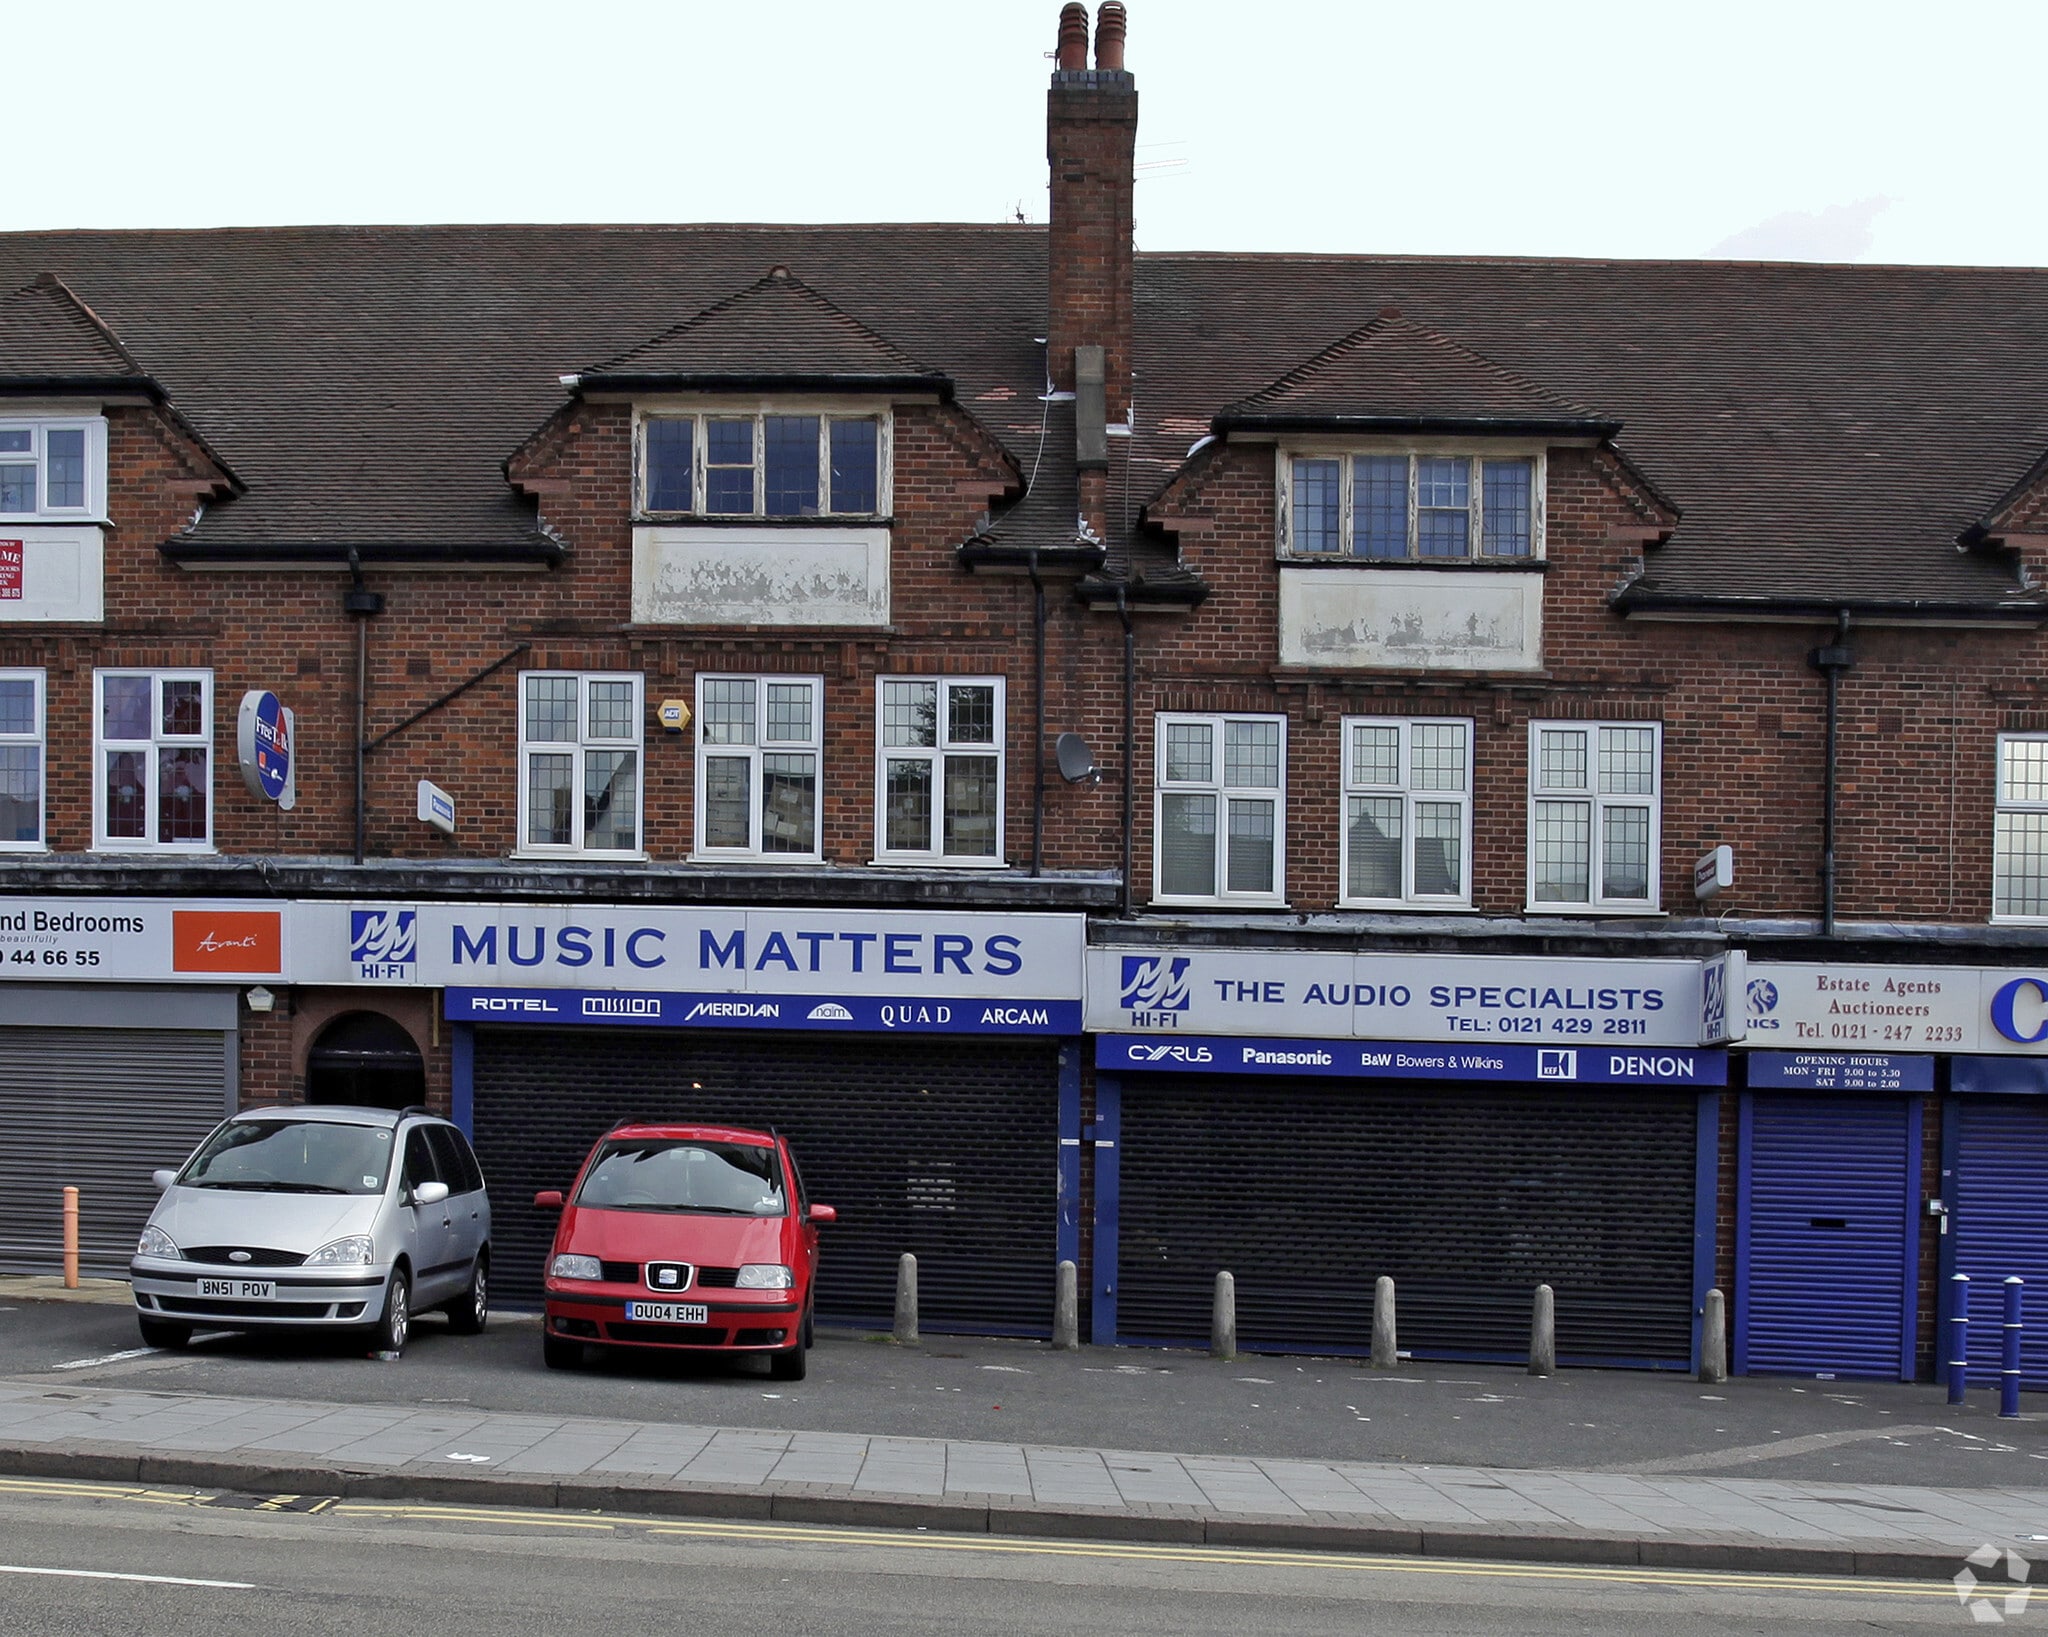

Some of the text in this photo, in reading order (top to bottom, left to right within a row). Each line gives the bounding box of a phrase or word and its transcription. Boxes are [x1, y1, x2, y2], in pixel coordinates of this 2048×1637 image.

[0, 910, 144, 932] nd Bedrooms
[0, 934, 58, 945] beautifully
[196, 931, 258, 952] Avanti
[10, 950, 36, 964] 44
[42, 950, 68, 966] 66
[75, 951, 100, 966] 55
[452, 925, 1023, 976] MUSIC MATTERS
[362, 964, 404, 979] HI-FI
[1214, 980, 1664, 1010] THE AUDIO SPECIALISTS
[1816, 975, 1942, 997] Estate Agents
[472, 997, 559, 1012] ROTEL
[684, 1002, 780, 1021] MERIDIAN
[880, 1006, 952, 1026] QUAD
[980, 1008, 1049, 1026] ARCAM
[1828, 998, 1930, 1016] Auctioneers
[1132, 1012, 1178, 1028] HI-FI
[1446, 1016, 1646, 1034] TEL: 0121 429 2811
[1796, 1022, 1824, 1038] Tel.
[1832, 1023, 1867, 1039] 0121
[1884, 1024, 1912, 1040] 247
[1925, 1026, 1962, 1041] 2233
[1128, 1044, 1214, 1062] CYRUS
[1242, 1047, 1333, 1066] Panasonic
[1361, 1053, 1392, 1066] B&W
[1396, 1054, 1445, 1068] Bowers
[1448, 1056, 1458, 1068] &
[1461, 1056, 1504, 1070] Wilkins
[1610, 1056, 1694, 1078] DENON
[1795, 1056, 1889, 1066] OPENING HOURS
[1784, 1066, 1809, 1076] MON
[1818, 1067, 1836, 1076] FRI
[1844, 1068, 1864, 1077] 9.00
[1816, 1078, 1900, 1088] SAT 9.00 to 2.00
[202, 1280, 270, 1296] BN51 POV
[676, 1307, 704, 1321] EHH
